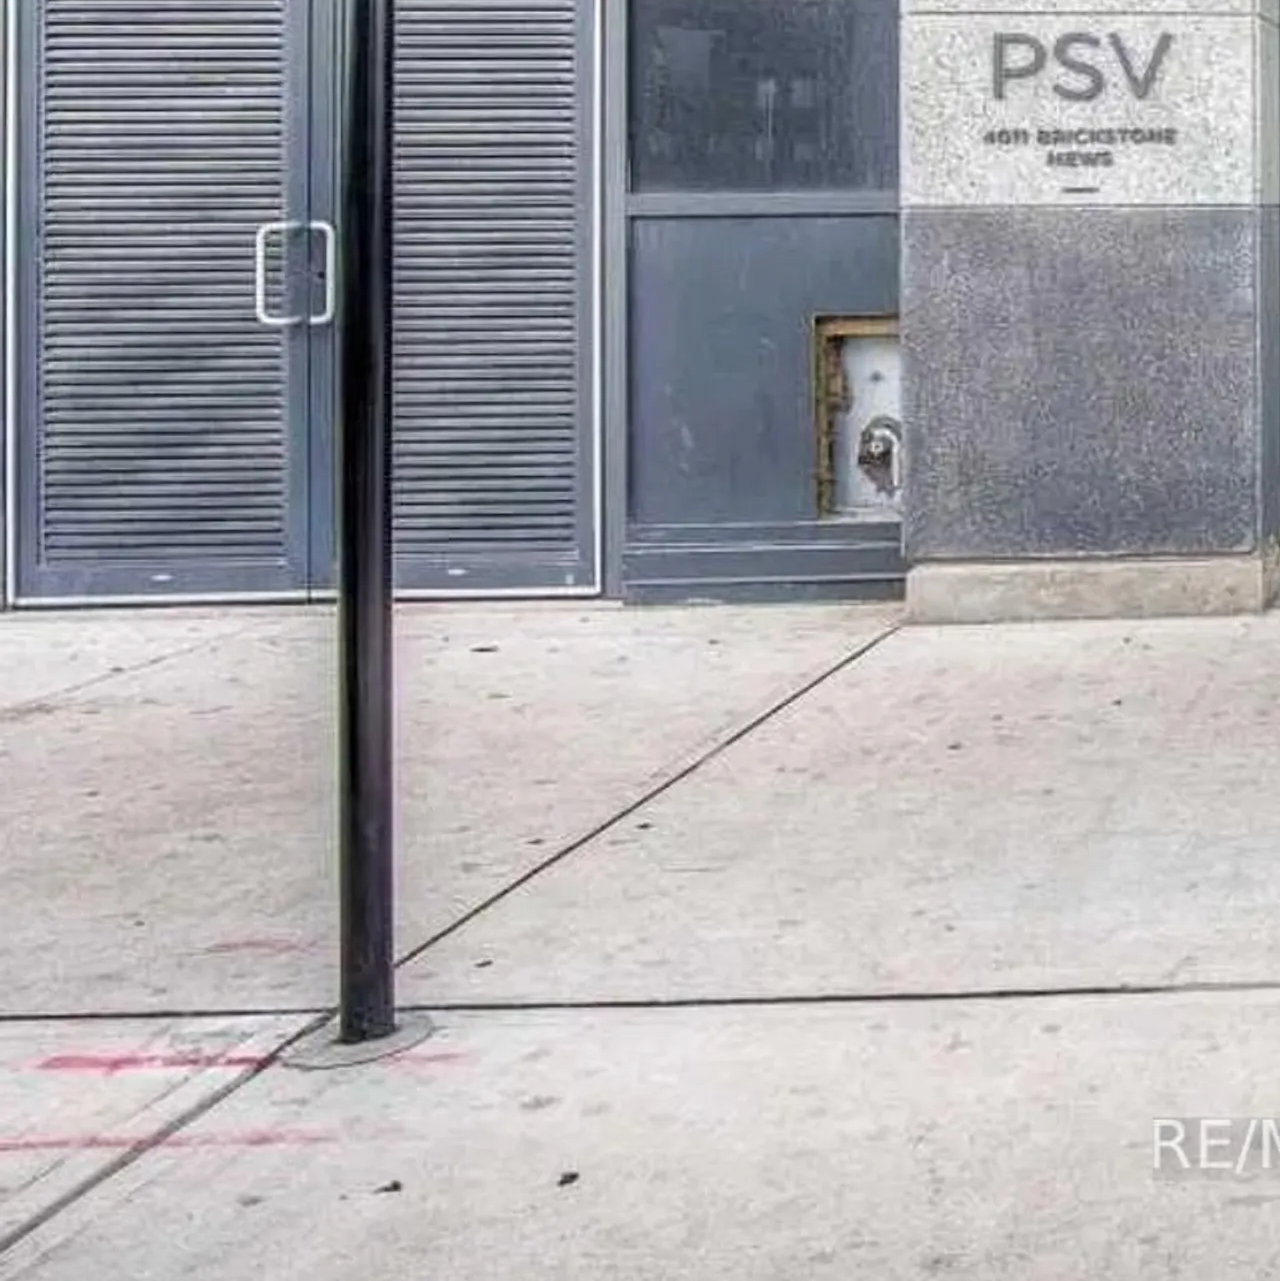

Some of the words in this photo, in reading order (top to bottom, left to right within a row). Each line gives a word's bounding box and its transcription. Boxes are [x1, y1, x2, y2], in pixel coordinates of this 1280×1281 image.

[993, 31, 1173, 101] PSV
[982, 128, 1029, 146] 4011
[1036, 127, 1179, 146] BRICKSTONE
